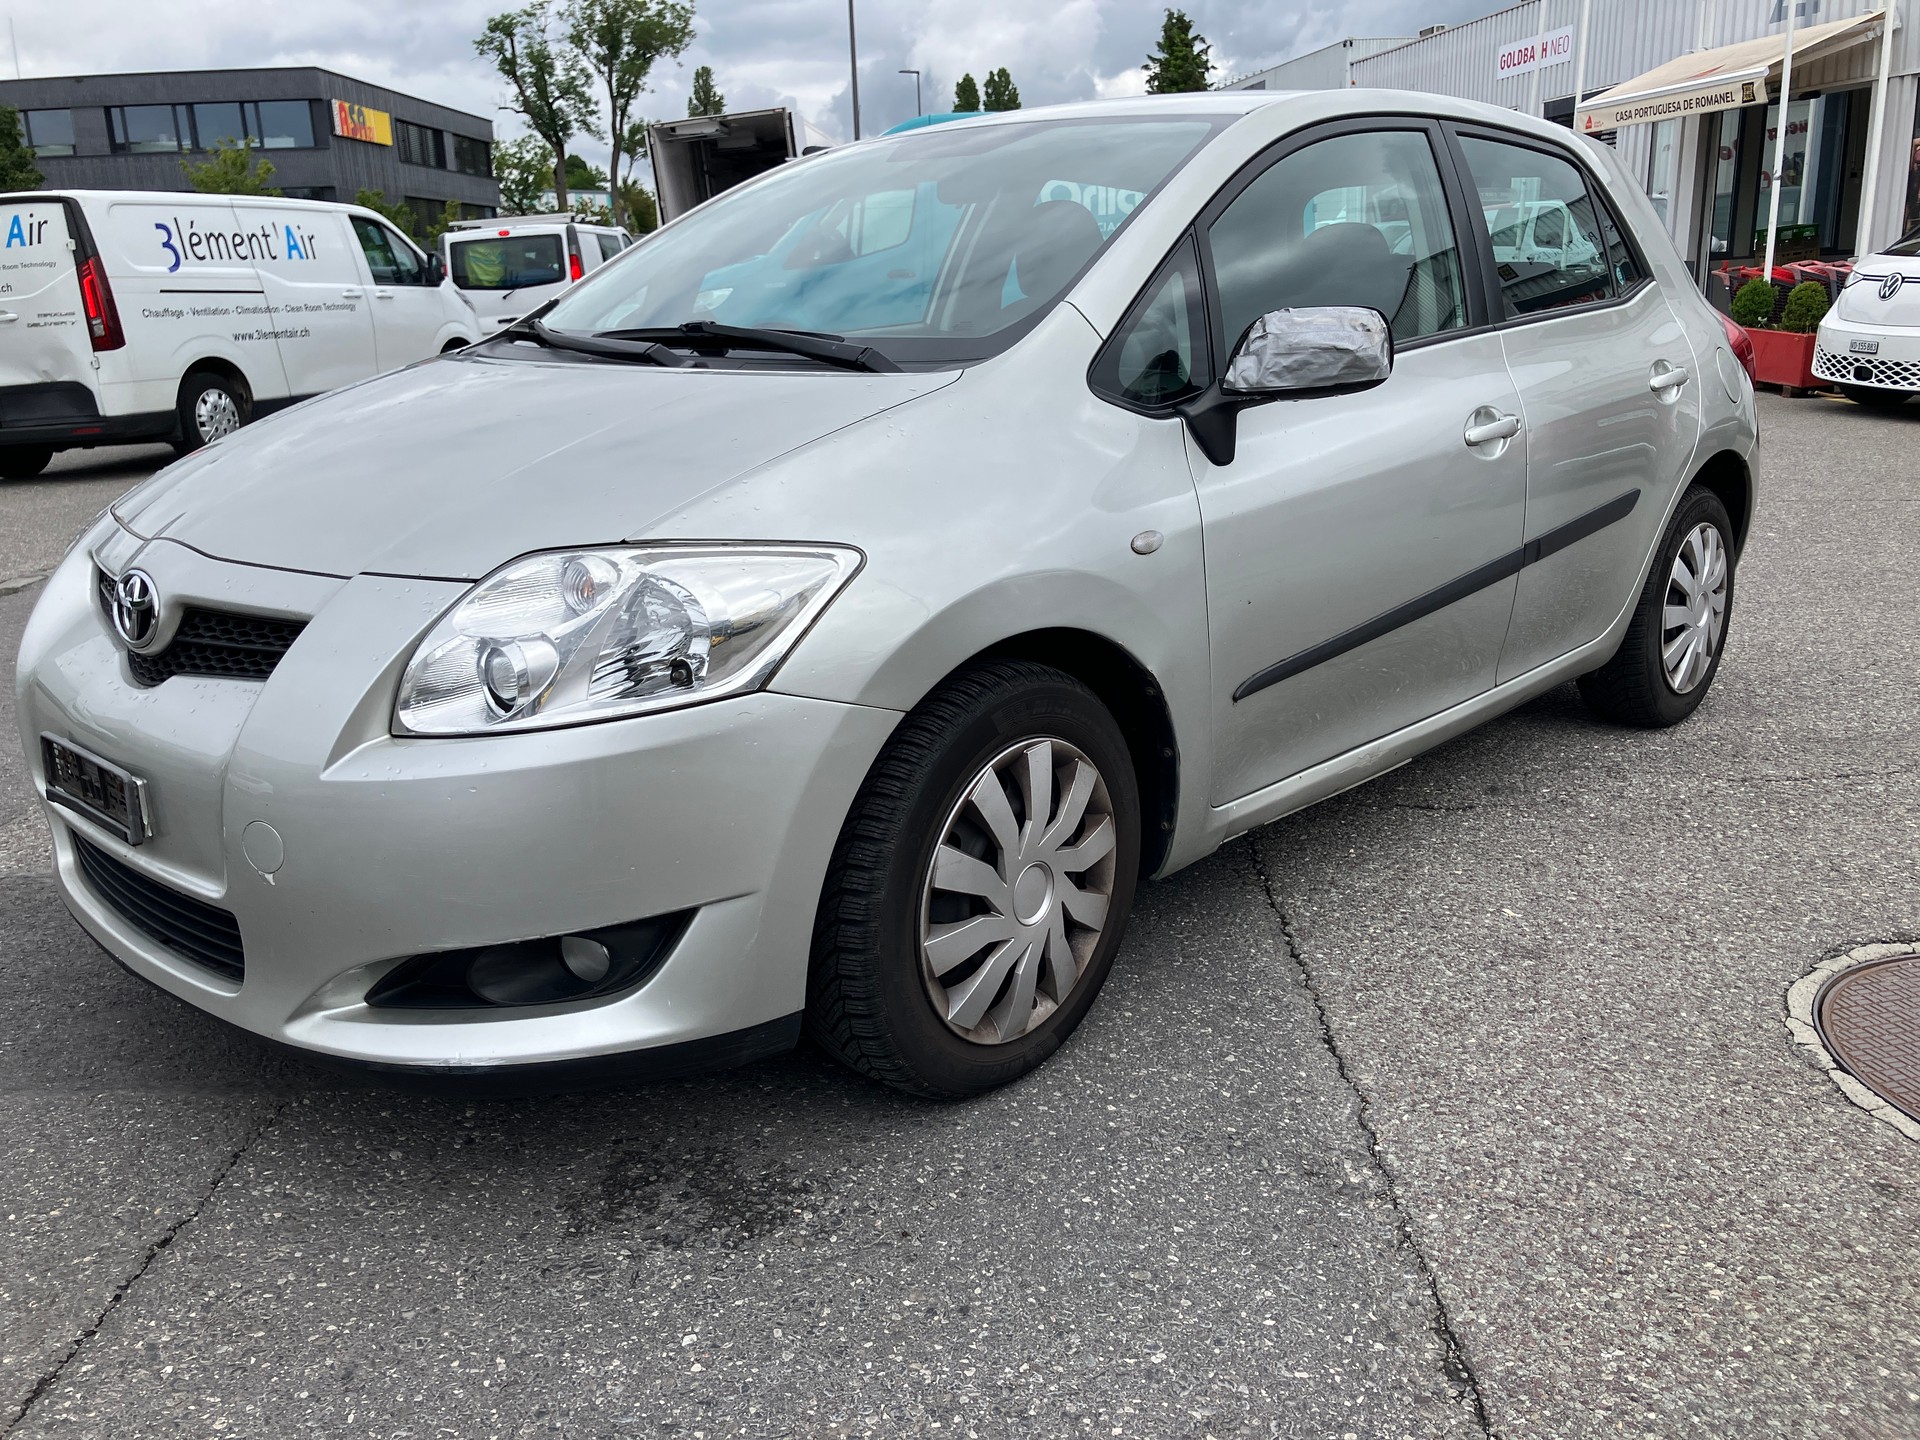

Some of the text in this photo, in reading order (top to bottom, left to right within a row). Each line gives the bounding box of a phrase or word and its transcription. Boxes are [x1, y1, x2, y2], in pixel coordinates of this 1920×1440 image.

[1500, 34, 1570, 71] GOLDBAH NEO
[1615, 110, 1633, 123] CASA
[1634, 103, 1682, 119] PORTUGUESA
[1683, 98, 1694, 110] DE
[1695, 91, 1735, 108] ROMANEL
[6, 213, 48, 248] Air
[20, 261, 57, 269] Technology
[142, 307, 185, 319] Chauffage
[190, 306, 231, 317] Ventilation
[235, 304, 280, 315] Climatisation
[285, 304, 304, 313] Clean
[304, 303, 322, 312] Room
[322, 302, 357, 313] Technology
[232, 326, 310, 341] www.3lementair.ch
